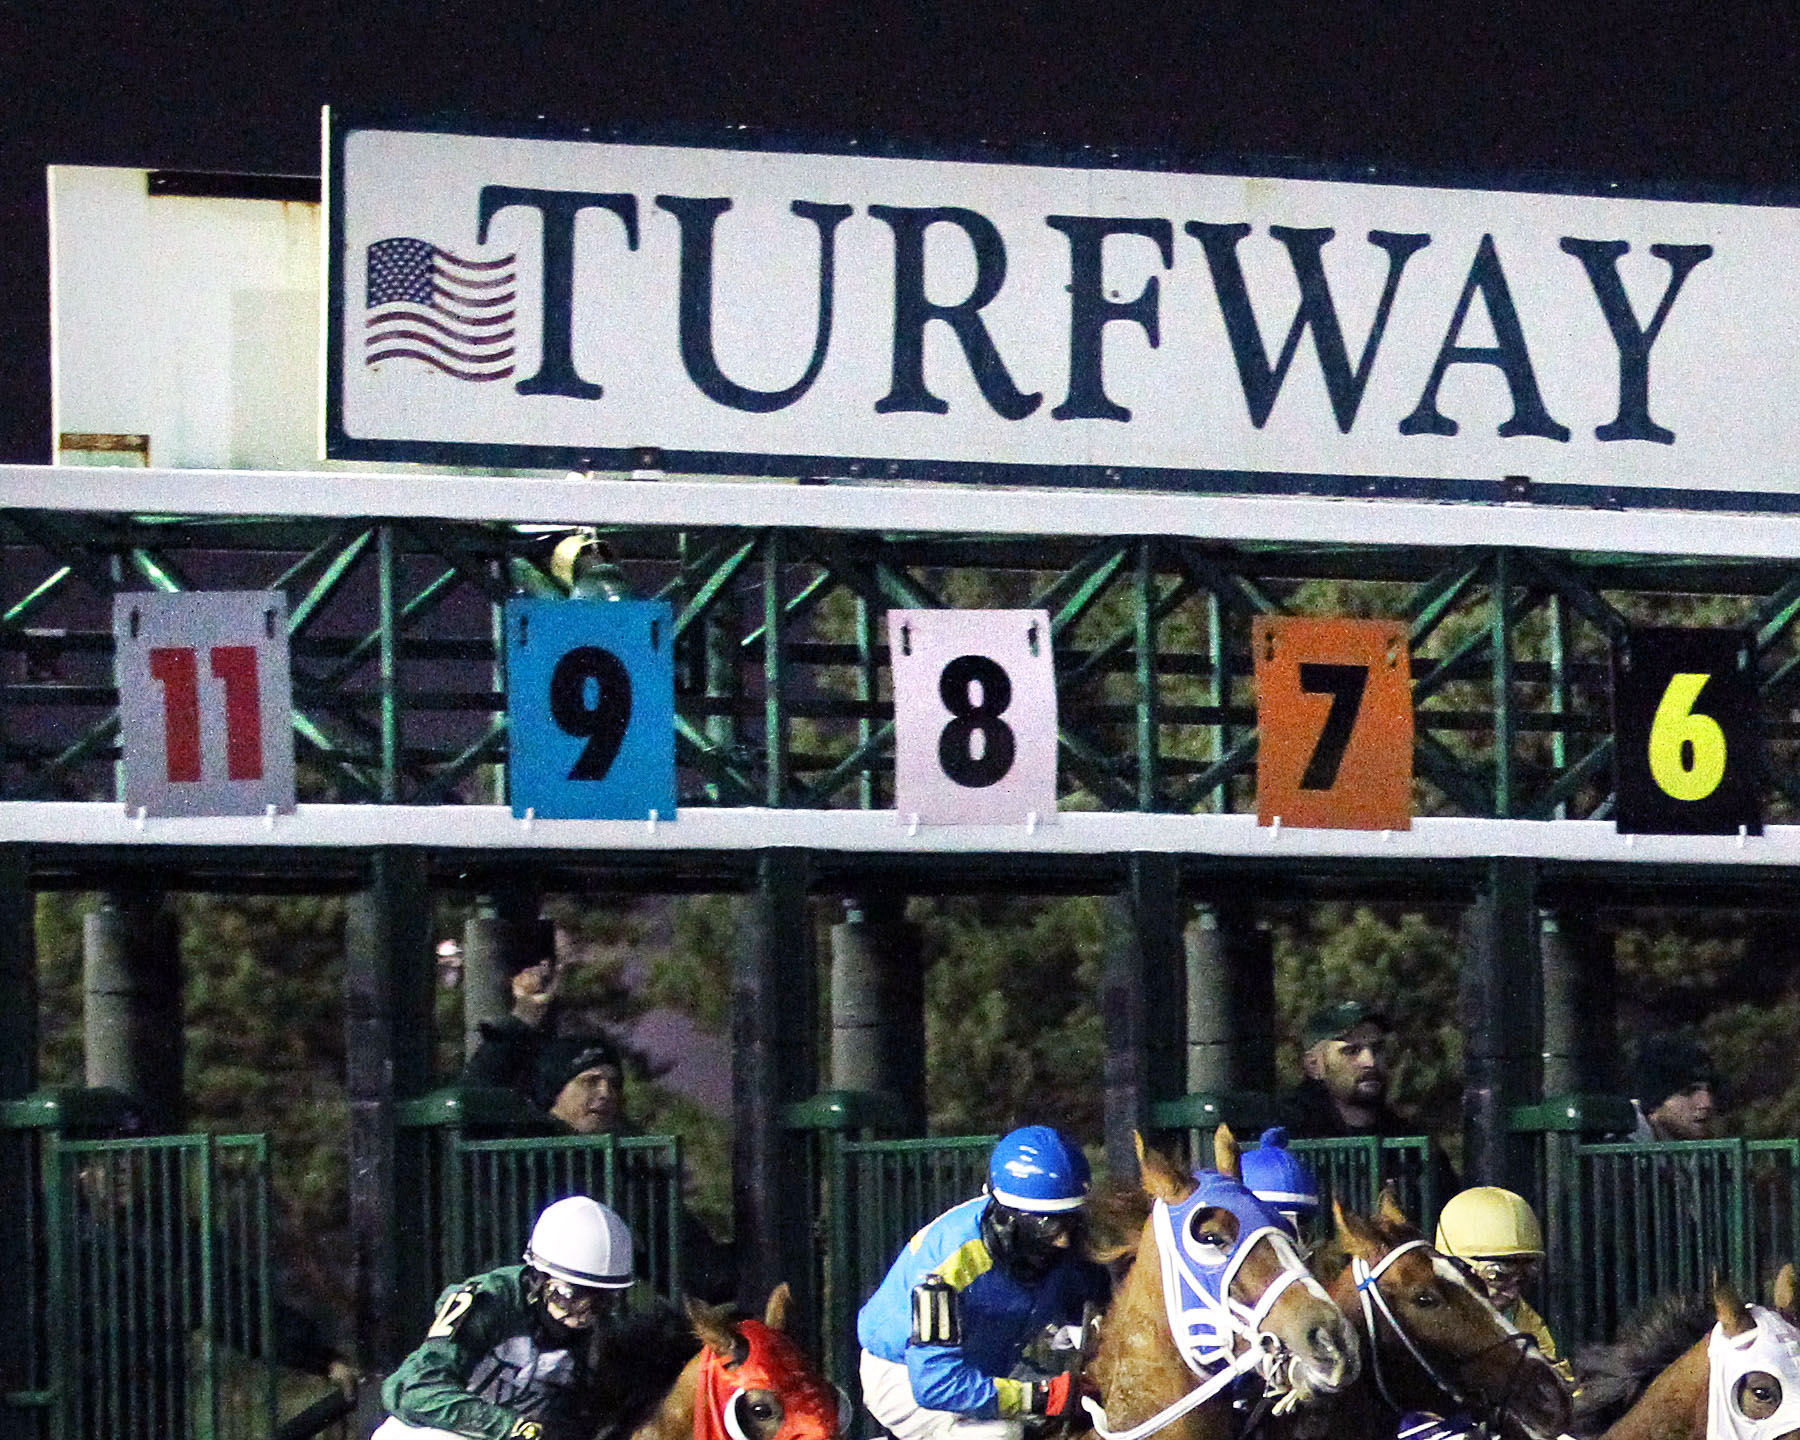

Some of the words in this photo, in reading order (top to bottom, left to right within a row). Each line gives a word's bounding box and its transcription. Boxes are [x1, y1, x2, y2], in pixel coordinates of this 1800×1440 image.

[477, 184, 1712, 444] TURFWAY
[149, 646, 263, 783] 11
[550, 647, 632, 781] 9
[937, 654, 1017, 789] 8
[1299, 664, 1369, 791] 7
[1648, 673, 1727, 801] 6
[428, 1291, 474, 1338] 12
[914, 1287, 950, 1342] 11
